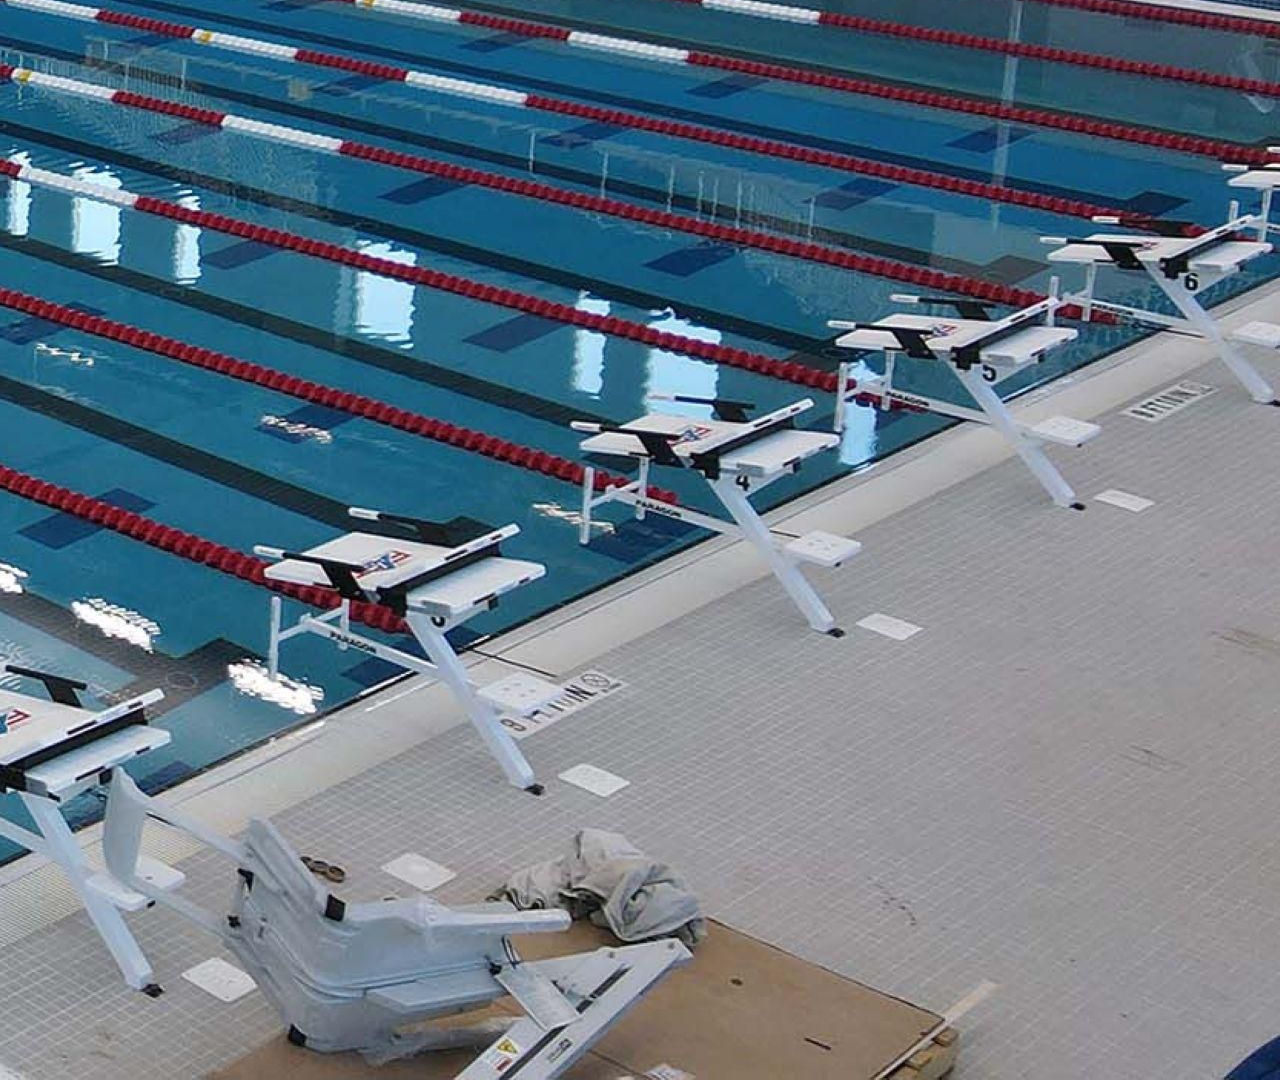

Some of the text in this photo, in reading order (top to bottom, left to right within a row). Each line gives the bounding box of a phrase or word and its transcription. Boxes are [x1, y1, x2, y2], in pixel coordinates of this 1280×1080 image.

[1184, 272, 1199, 291] 6
[981, 364, 997, 382] 5
[735, 474, 750, 492] 4
